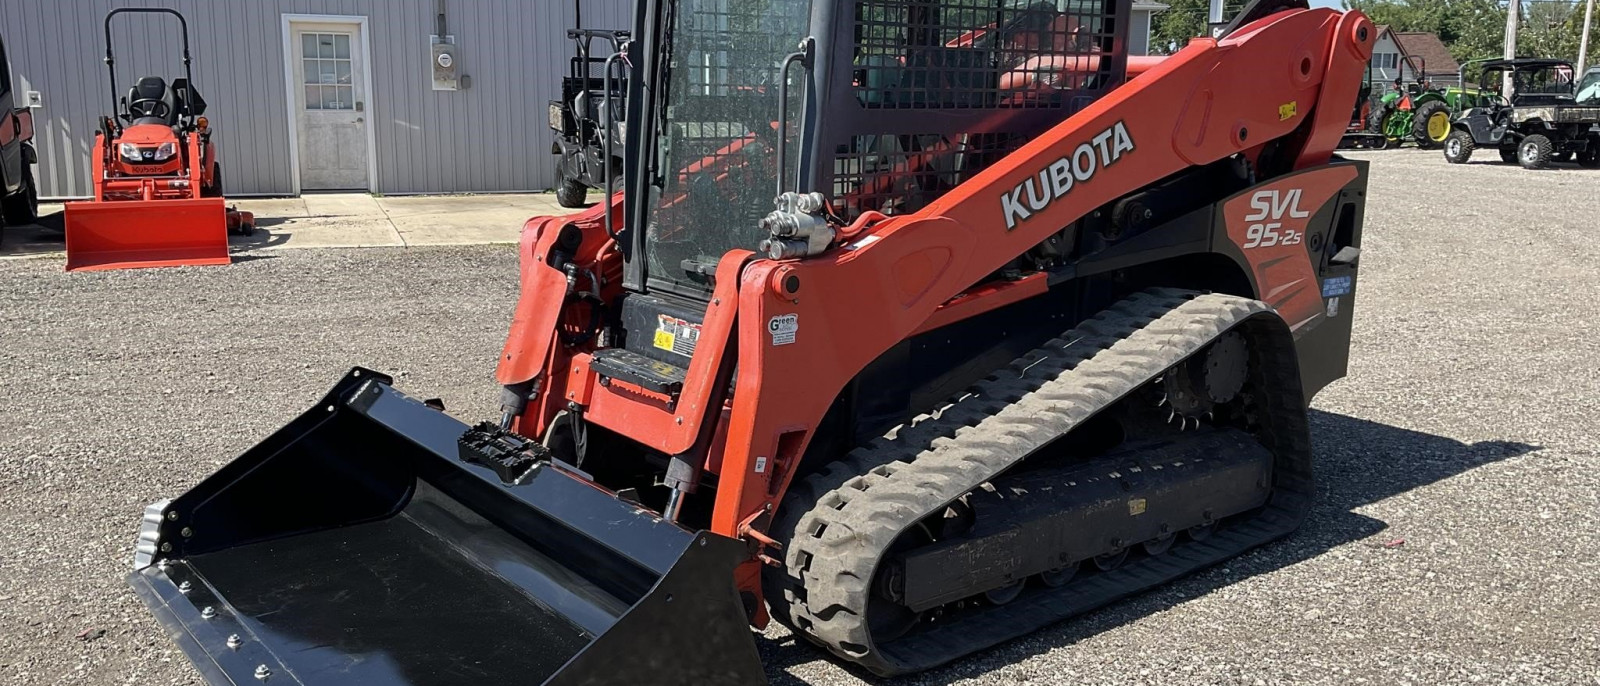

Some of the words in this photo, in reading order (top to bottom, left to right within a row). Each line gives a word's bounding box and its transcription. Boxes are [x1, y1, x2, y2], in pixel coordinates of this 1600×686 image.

[1000, 120, 1135, 230] KUBOTA
[1244, 188, 1310, 222] SVL
[770, 317, 795, 331] Green
